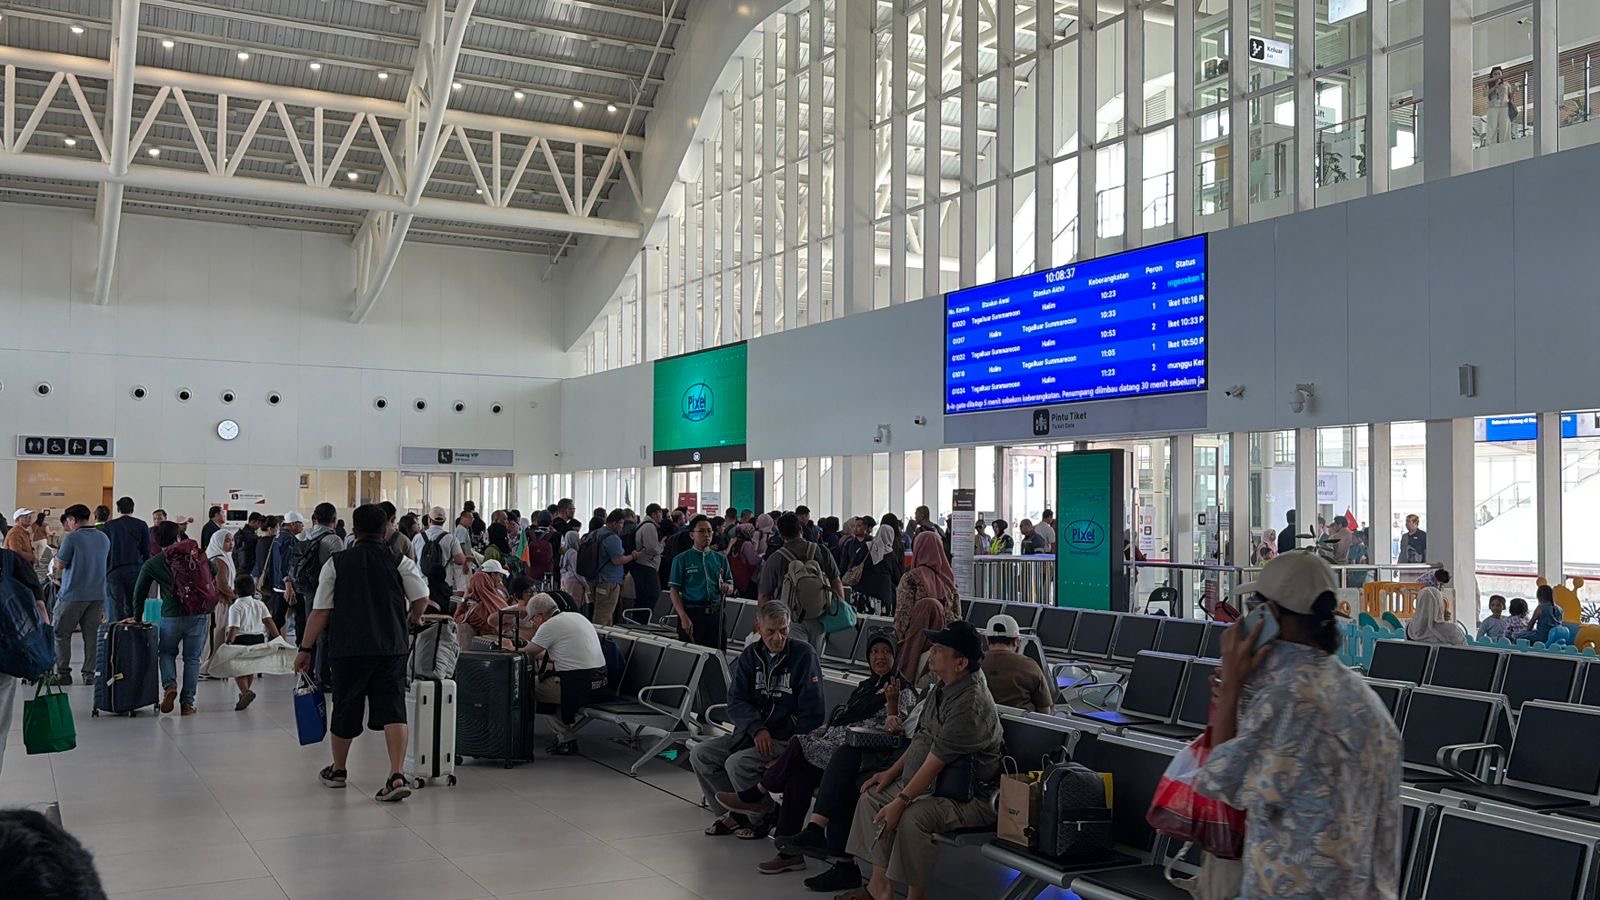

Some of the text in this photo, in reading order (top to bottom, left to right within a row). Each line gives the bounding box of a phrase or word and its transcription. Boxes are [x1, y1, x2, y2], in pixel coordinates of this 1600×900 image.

[1044, 268, 1075, 282] 10:08:37
[1089, 273, 1129, 285] Keberangkatan
[1176, 260, 1195, 268] Status
[1101, 290, 1116, 298] 10:23
[1101, 310, 1116, 318] 10:33
[1182, 296, 1197, 304] 10:18
[1181, 317, 1198, 325] 10:33
[1181, 338, 1198, 346] 10:50
[1002, 396, 1021, 404] sebelum
[1022, 393, 1060, 402] keberangkatan.
[1062, 389, 1094, 398] Penumpang
[1095, 386, 1118, 394] diimbau
[1119, 384, 1139, 392] datang
[1150, 380, 1168, 388] menit
[1170, 378, 1196, 386] sebelum
[688, 393, 706, 410] Pixel
[1052, 412, 1087, 421] Pintu Tiket
[1402, 468, 1407, 477] 2
[1072, 527, 1095, 540] Pixel
